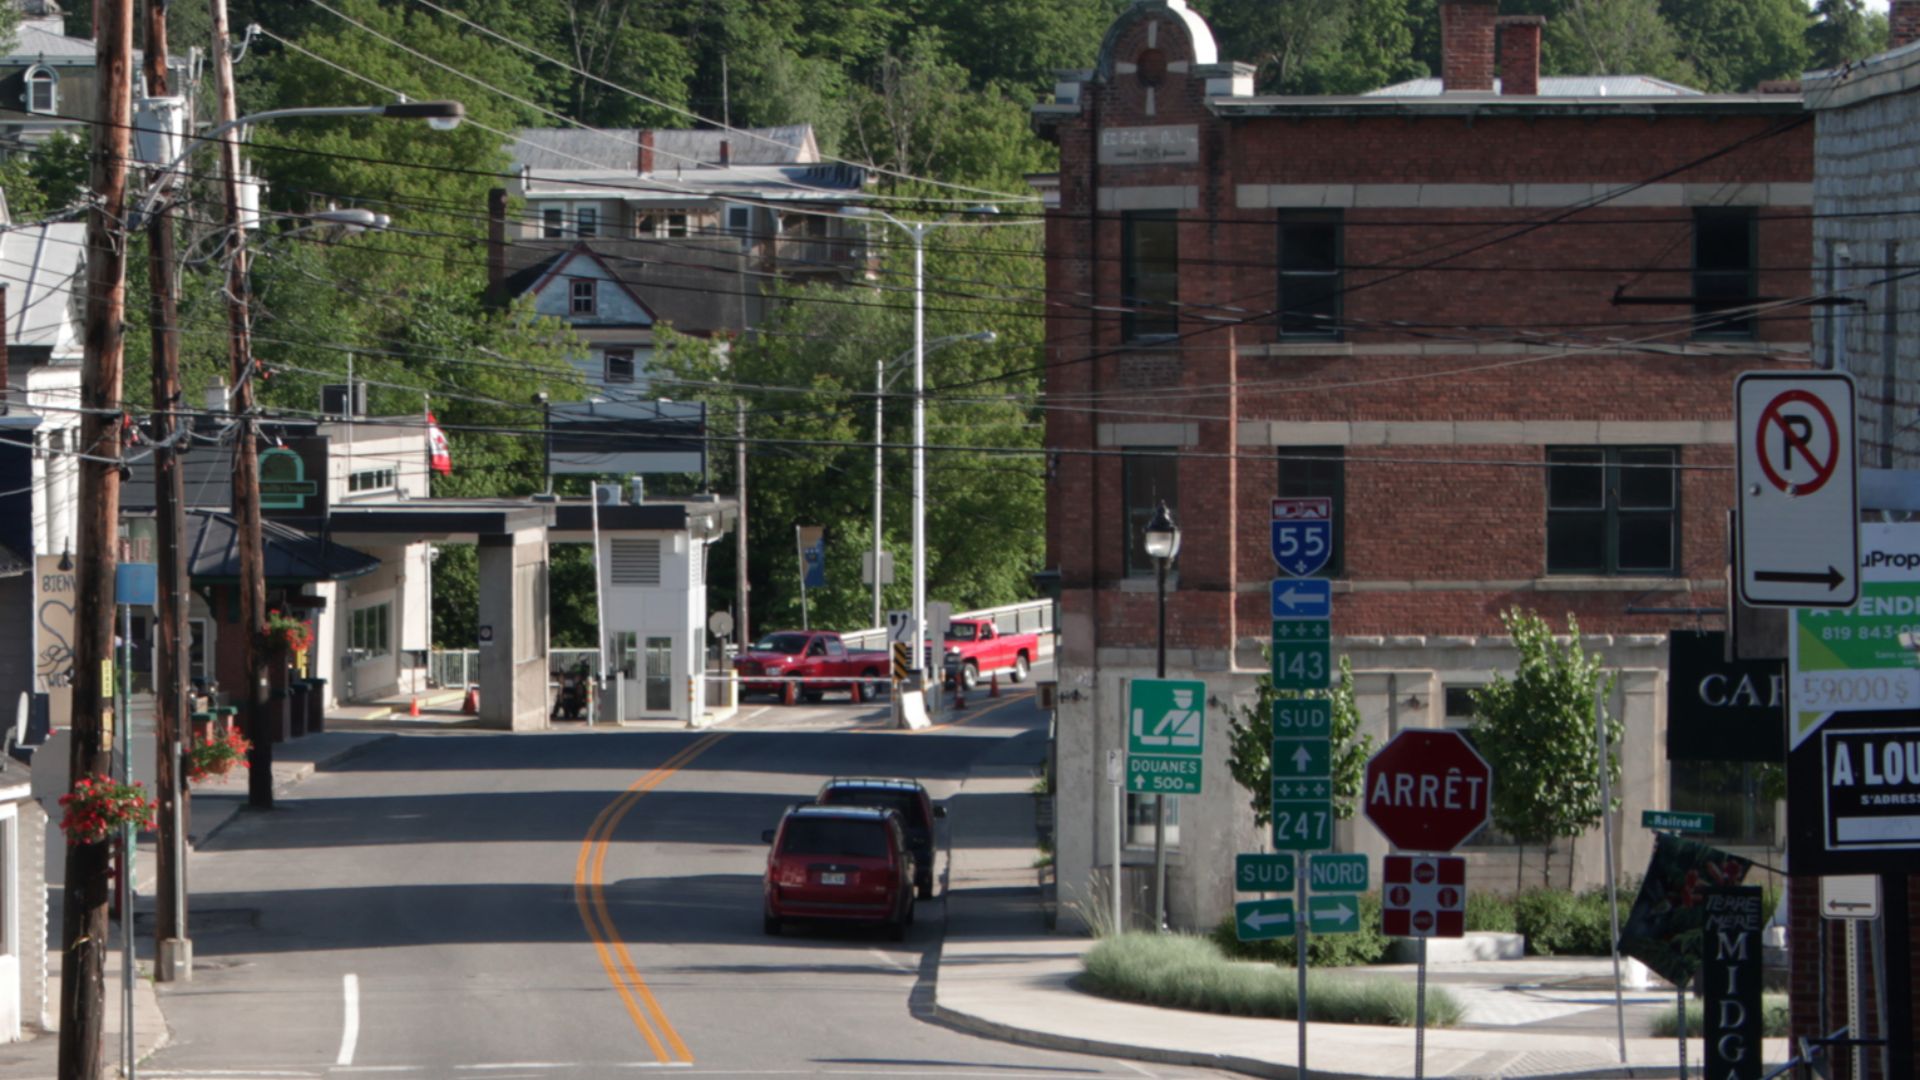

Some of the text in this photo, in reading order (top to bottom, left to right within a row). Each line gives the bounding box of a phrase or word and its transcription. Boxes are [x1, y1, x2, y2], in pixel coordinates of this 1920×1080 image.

[1279, 527, 1325, 556] 55
[1822, 626, 1850, 640] 819
[1278, 652, 1324, 680] 143
[1803, 674, 1909, 704] 59000 $
[1280, 709, 1325, 728] SUD
[1131, 759, 1198, 775] DOUANES
[1832, 741, 1854, 786] A
[1153, 776, 1195, 790] 500 m
[1371, 768, 1483, 810] ARRÊT
[1278, 811, 1327, 841] 247
[1654, 815, 1702, 829] Railroad
[1243, 863, 1290, 882] SUD
[1312, 862, 1366, 885] NORD
